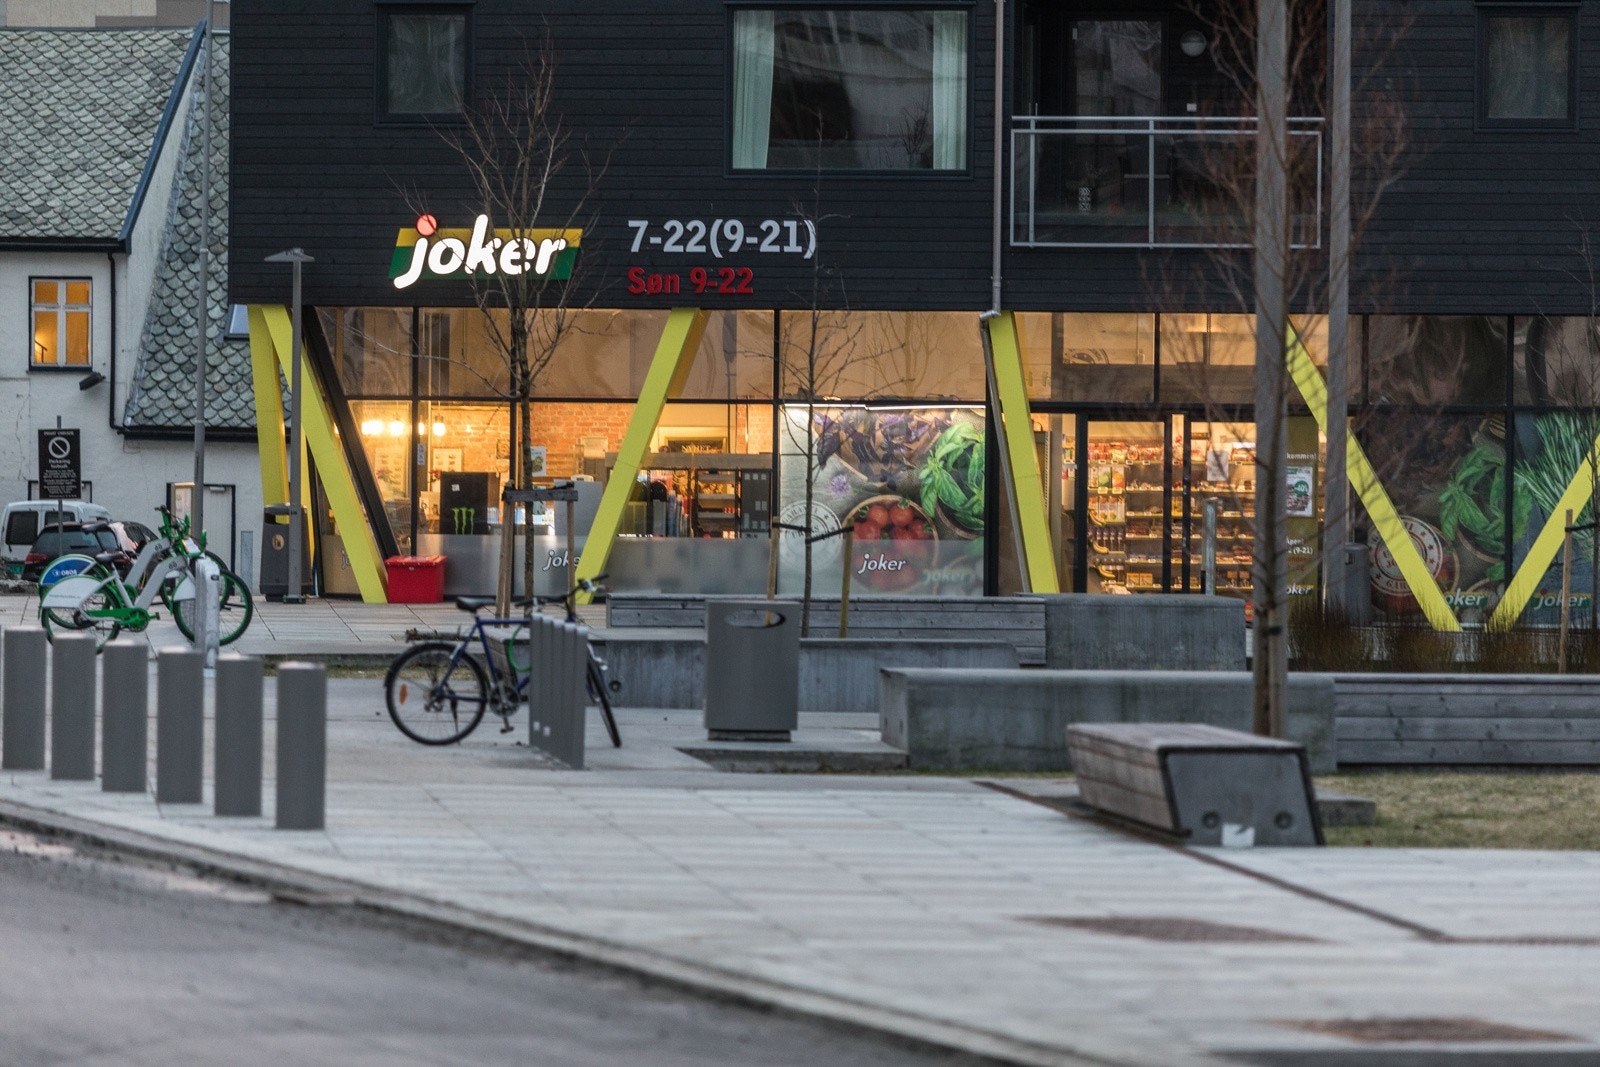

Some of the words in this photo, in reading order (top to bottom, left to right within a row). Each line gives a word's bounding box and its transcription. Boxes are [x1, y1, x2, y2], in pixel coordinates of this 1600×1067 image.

[393, 213, 567, 289] joker
[627, 219, 817, 259] 7-22(9-21)
[627, 267, 680, 295] Søn
[690, 267, 754, 294] 9-22
[857, 553, 907, 575] joker
[1444, 588, 1486, 606] oker
